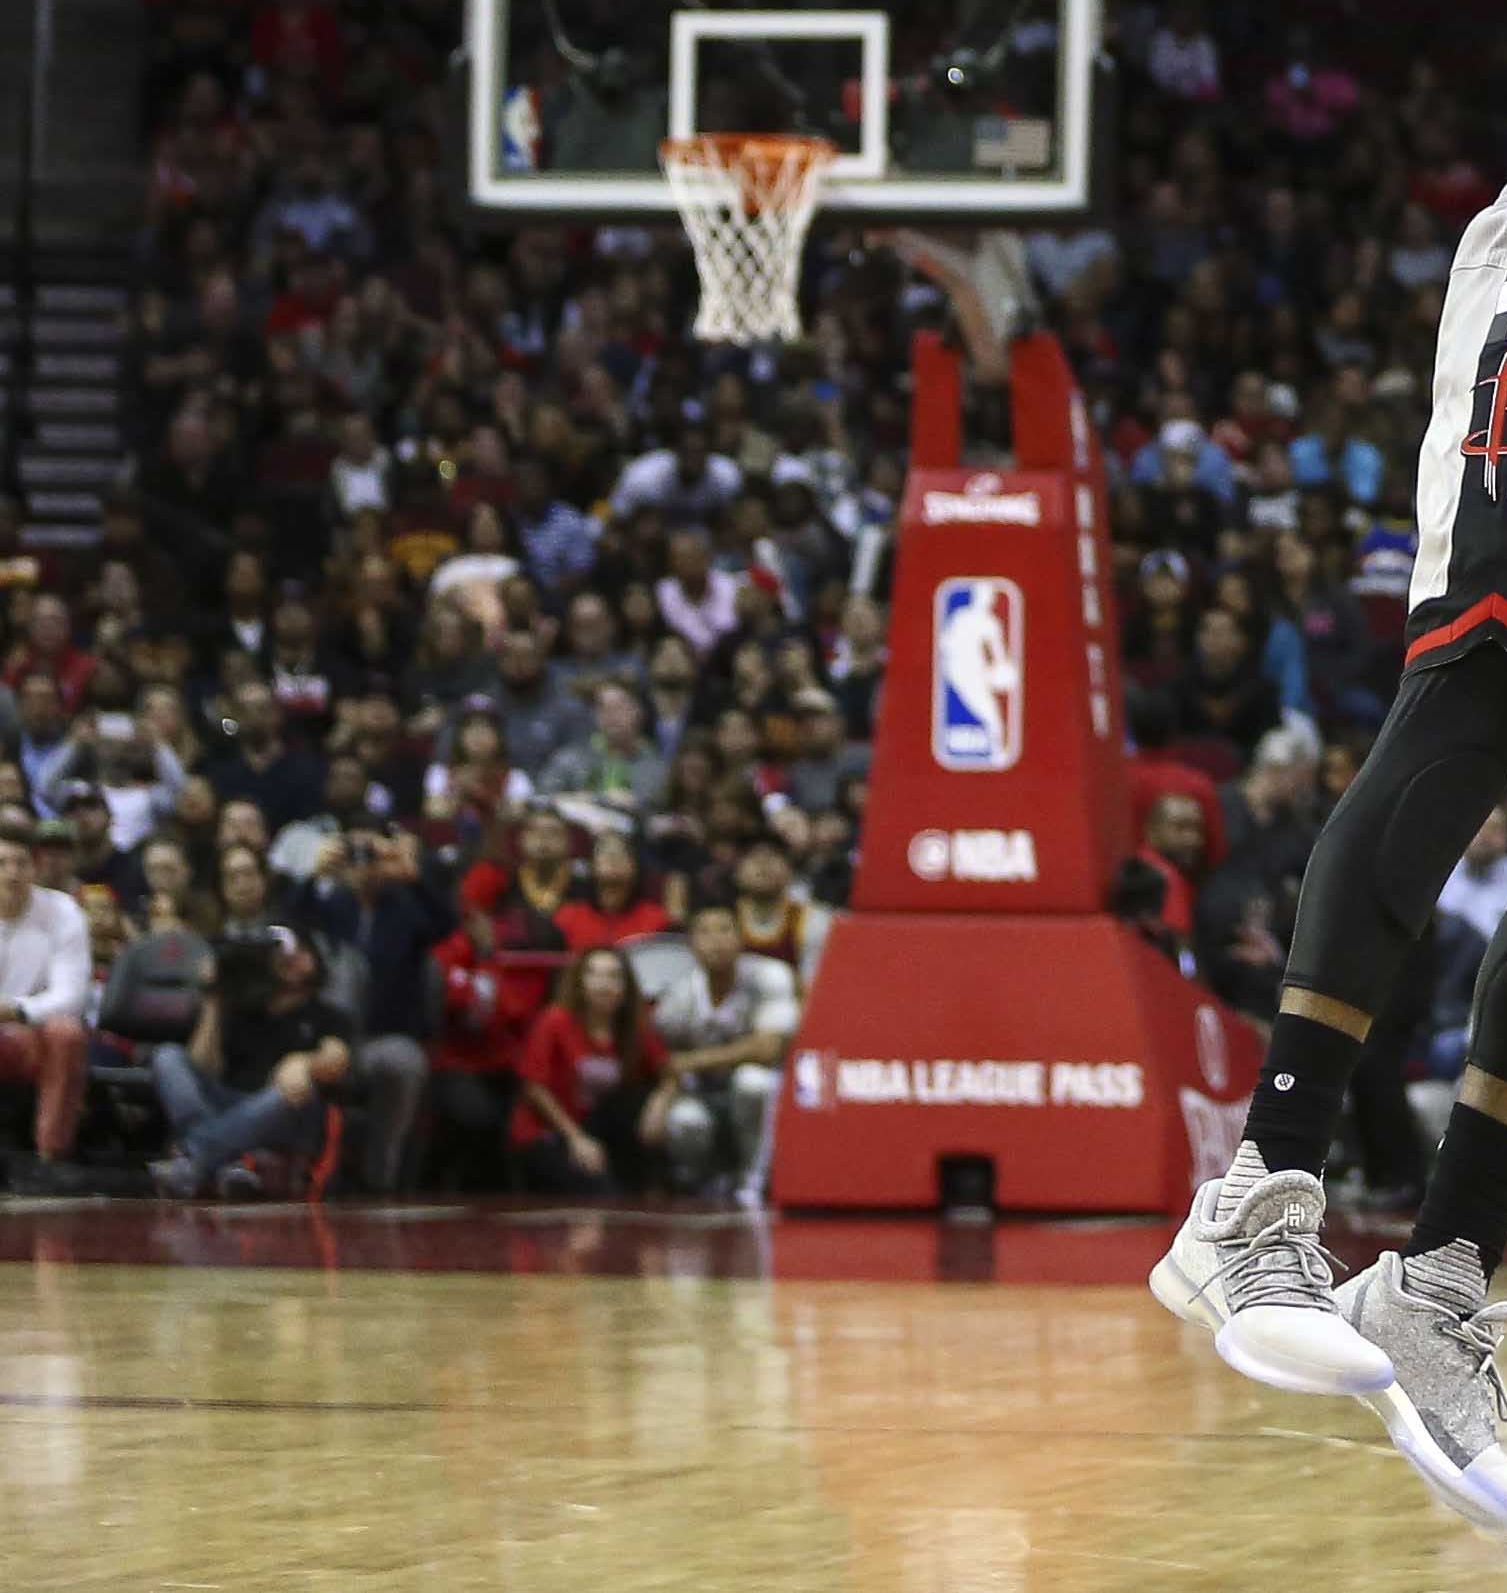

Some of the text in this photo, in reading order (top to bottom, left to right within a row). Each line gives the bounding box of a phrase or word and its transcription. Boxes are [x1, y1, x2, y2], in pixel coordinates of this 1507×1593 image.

[837, 1059, 1143, 1107] NBA LEAGUE PASS
